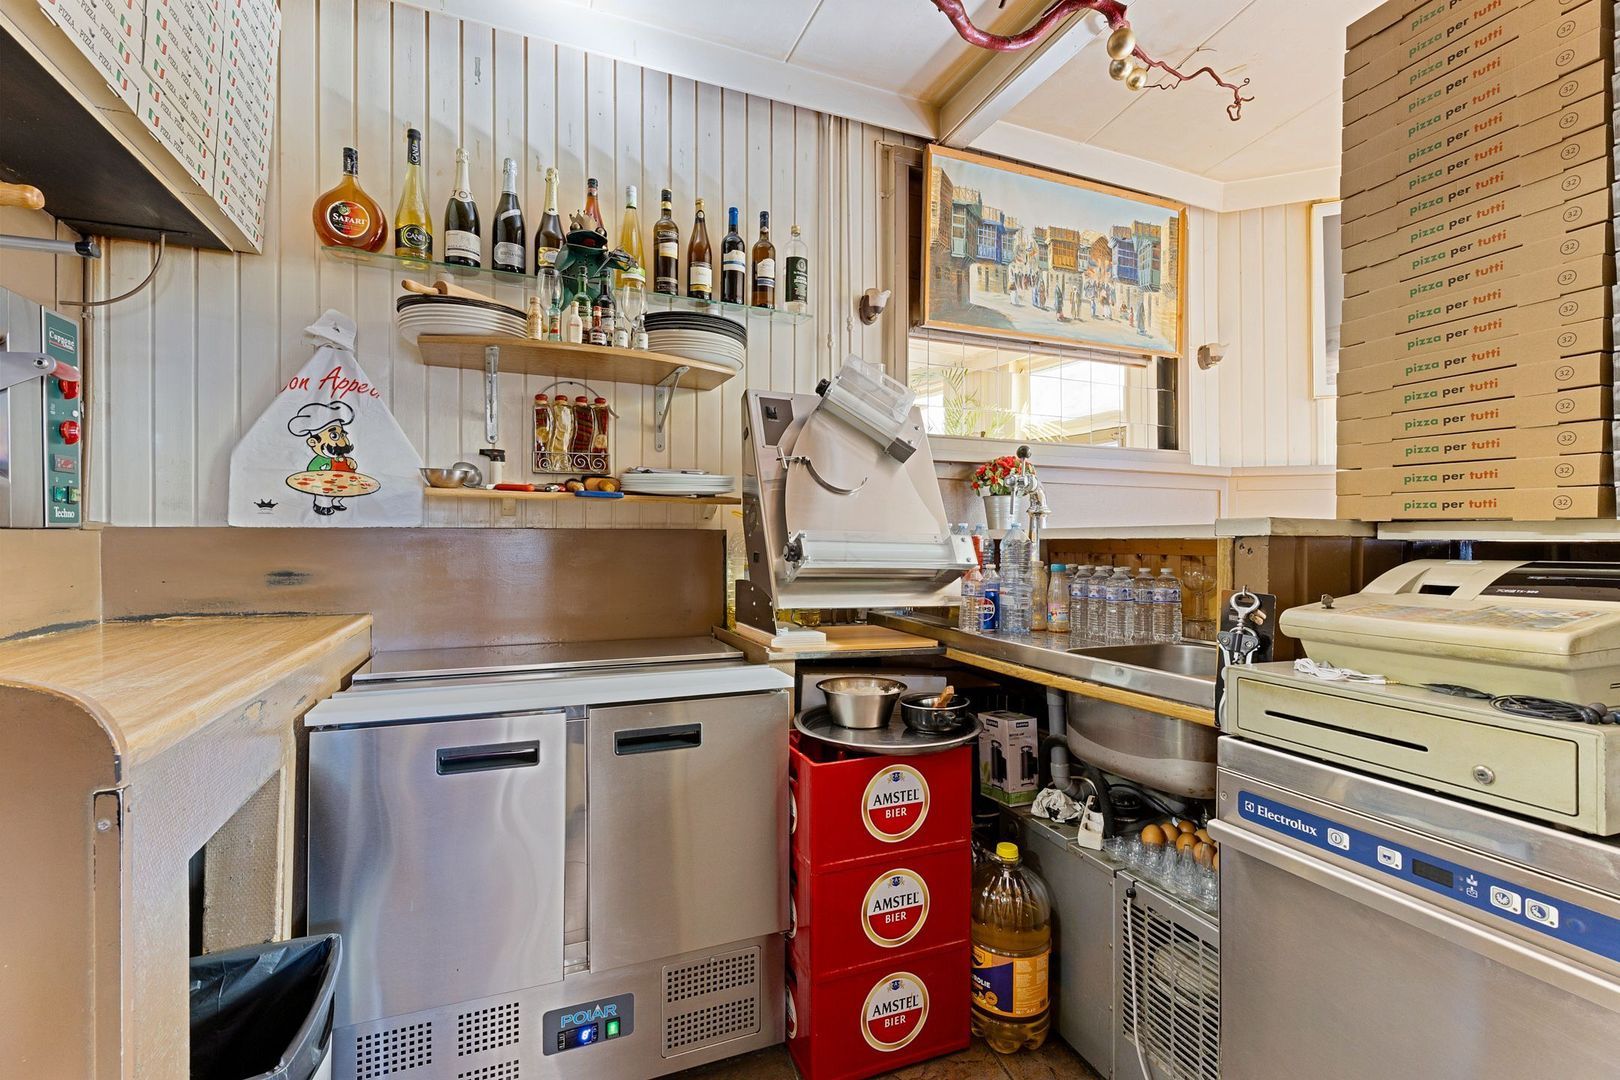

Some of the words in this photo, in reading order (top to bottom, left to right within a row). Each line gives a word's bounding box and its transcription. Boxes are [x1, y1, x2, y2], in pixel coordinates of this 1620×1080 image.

[1411, 5, 1445, 31] pizza
[1408, 31, 1442, 58] pizza
[1446, 17, 1469, 37] per
[1560, 25, 1572, 34] 32
[1409, 59, 1443, 85] pizza
[1447, 46, 1470, 65] per
[1474, 25, 1503, 48] tutti
[1559, 54, 1571, 63] 32
[1408, 88, 1442, 113] pizza
[1446, 75, 1468, 94] per
[1472, 57, 1500, 78] tutti
[1563, 85, 1574, 94] 32
[1408, 113, 1441, 138] pizza
[1446, 102, 1468, 120] per
[1472, 84, 1500, 104] tutti
[1563, 116, 1574, 125] 32
[1408, 140, 1442, 162] pizza
[1447, 130, 1469, 146] per
[1474, 112, 1503, 133] tutti
[1564, 148, 1576, 157] 32
[1409, 168, 1442, 190] pizza
[1447, 157, 1469, 174] per
[1474, 142, 1503, 161] tutti
[1565, 179, 1577, 188] 32
[1410, 196, 1443, 216] pizza
[1448, 186, 1471, 202] per
[1475, 171, 1504, 190] tutti
[332, 213, 366, 225] SAFARI
[1410, 224, 1444, 244] pizza
[1449, 214, 1472, 230] per
[1476, 201, 1505, 219] tutti
[1567, 210, 1578, 219] 32
[1412, 251, 1446, 270] pizza
[1450, 242, 1473, 258] per
[1477, 230, 1506, 247] tutti
[1564, 243, 1575, 251] 32
[1409, 280, 1443, 297] pizza
[1448, 272, 1470, 287] per
[1475, 262, 1504, 278] tutti
[1561, 273, 1573, 281] 32
[1407, 306, 1441, 323] pizza
[1446, 300, 1468, 314] per
[1472, 289, 1501, 304] tutti
[1407, 335, 1441, 350] pizza
[1446, 328, 1469, 342] per
[1473, 318, 1502, 334] tutti
[1561, 335, 1573, 343] 32
[1405, 360, 1439, 376] pizza
[1444, 355, 1467, 369] per
[1471, 347, 1500, 361] tutti
[1559, 369, 1570, 377] 32
[281, 376, 310, 393] on
[1404, 389, 1437, 403] pizza
[1442, 385, 1465, 398] per
[1469, 378, 1498, 391] tutti
[1559, 402, 1571, 410] 32
[1405, 418, 1438, 430] pizza
[1443, 414, 1466, 426] per
[1470, 409, 1499, 421] tutti
[1561, 434, 1572, 442] 32
[1405, 445, 1439, 456] pizza
[1444, 442, 1466, 454] per
[1471, 439, 1500, 450] tutti
[1404, 473, 1437, 485] pizza
[1442, 472, 1465, 483] per
[1469, 469, 1498, 480] tutti
[1559, 466, 1570, 474] 32
[1404, 500, 1437, 511] pizza
[1442, 500, 1464, 511] per
[1469, 498, 1497, 508] tutti
[1557, 498, 1568, 506] 32
[54, 506, 75, 518] Techno
[872, 788, 919, 806] AMSTEL
[884, 806, 907, 819] BIER
[1256, 804, 1318, 836] Electrolux
[872, 892, 919, 912] AMSTEL
[884, 911, 907, 924] BIER
[872, 995, 919, 1018] AMSTEL
[560, 1004, 617, 1028] POLAR
[884, 1015, 907, 1028] BIER
